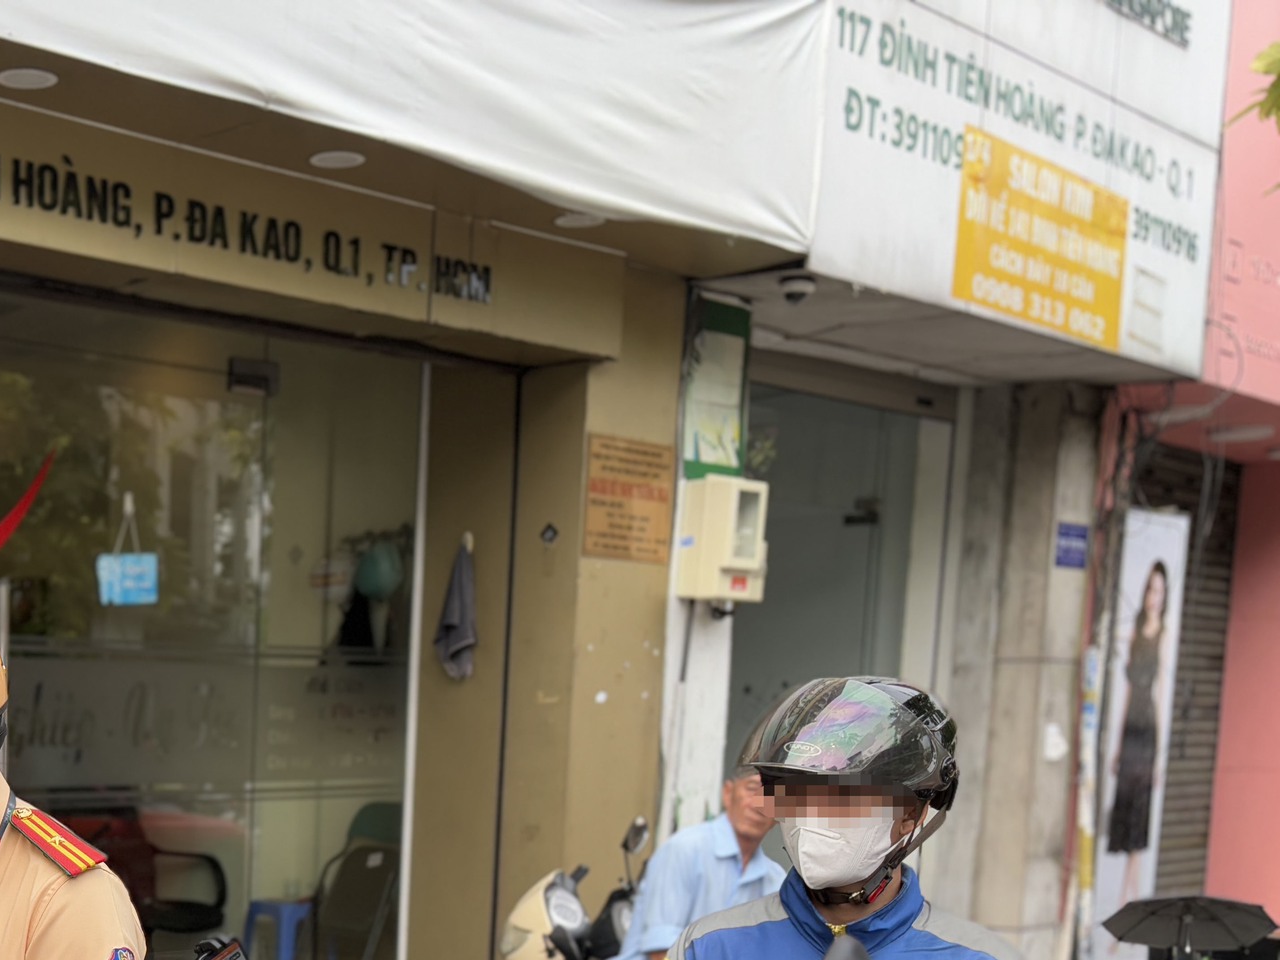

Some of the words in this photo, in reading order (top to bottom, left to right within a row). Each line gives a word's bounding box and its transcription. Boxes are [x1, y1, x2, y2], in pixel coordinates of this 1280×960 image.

[837, 6, 872, 56] 117
[995, 80, 1065, 142] HOÀNG
[12, 155, 143, 238] HOÀNG,
[239, 210, 313, 272] KAO,
